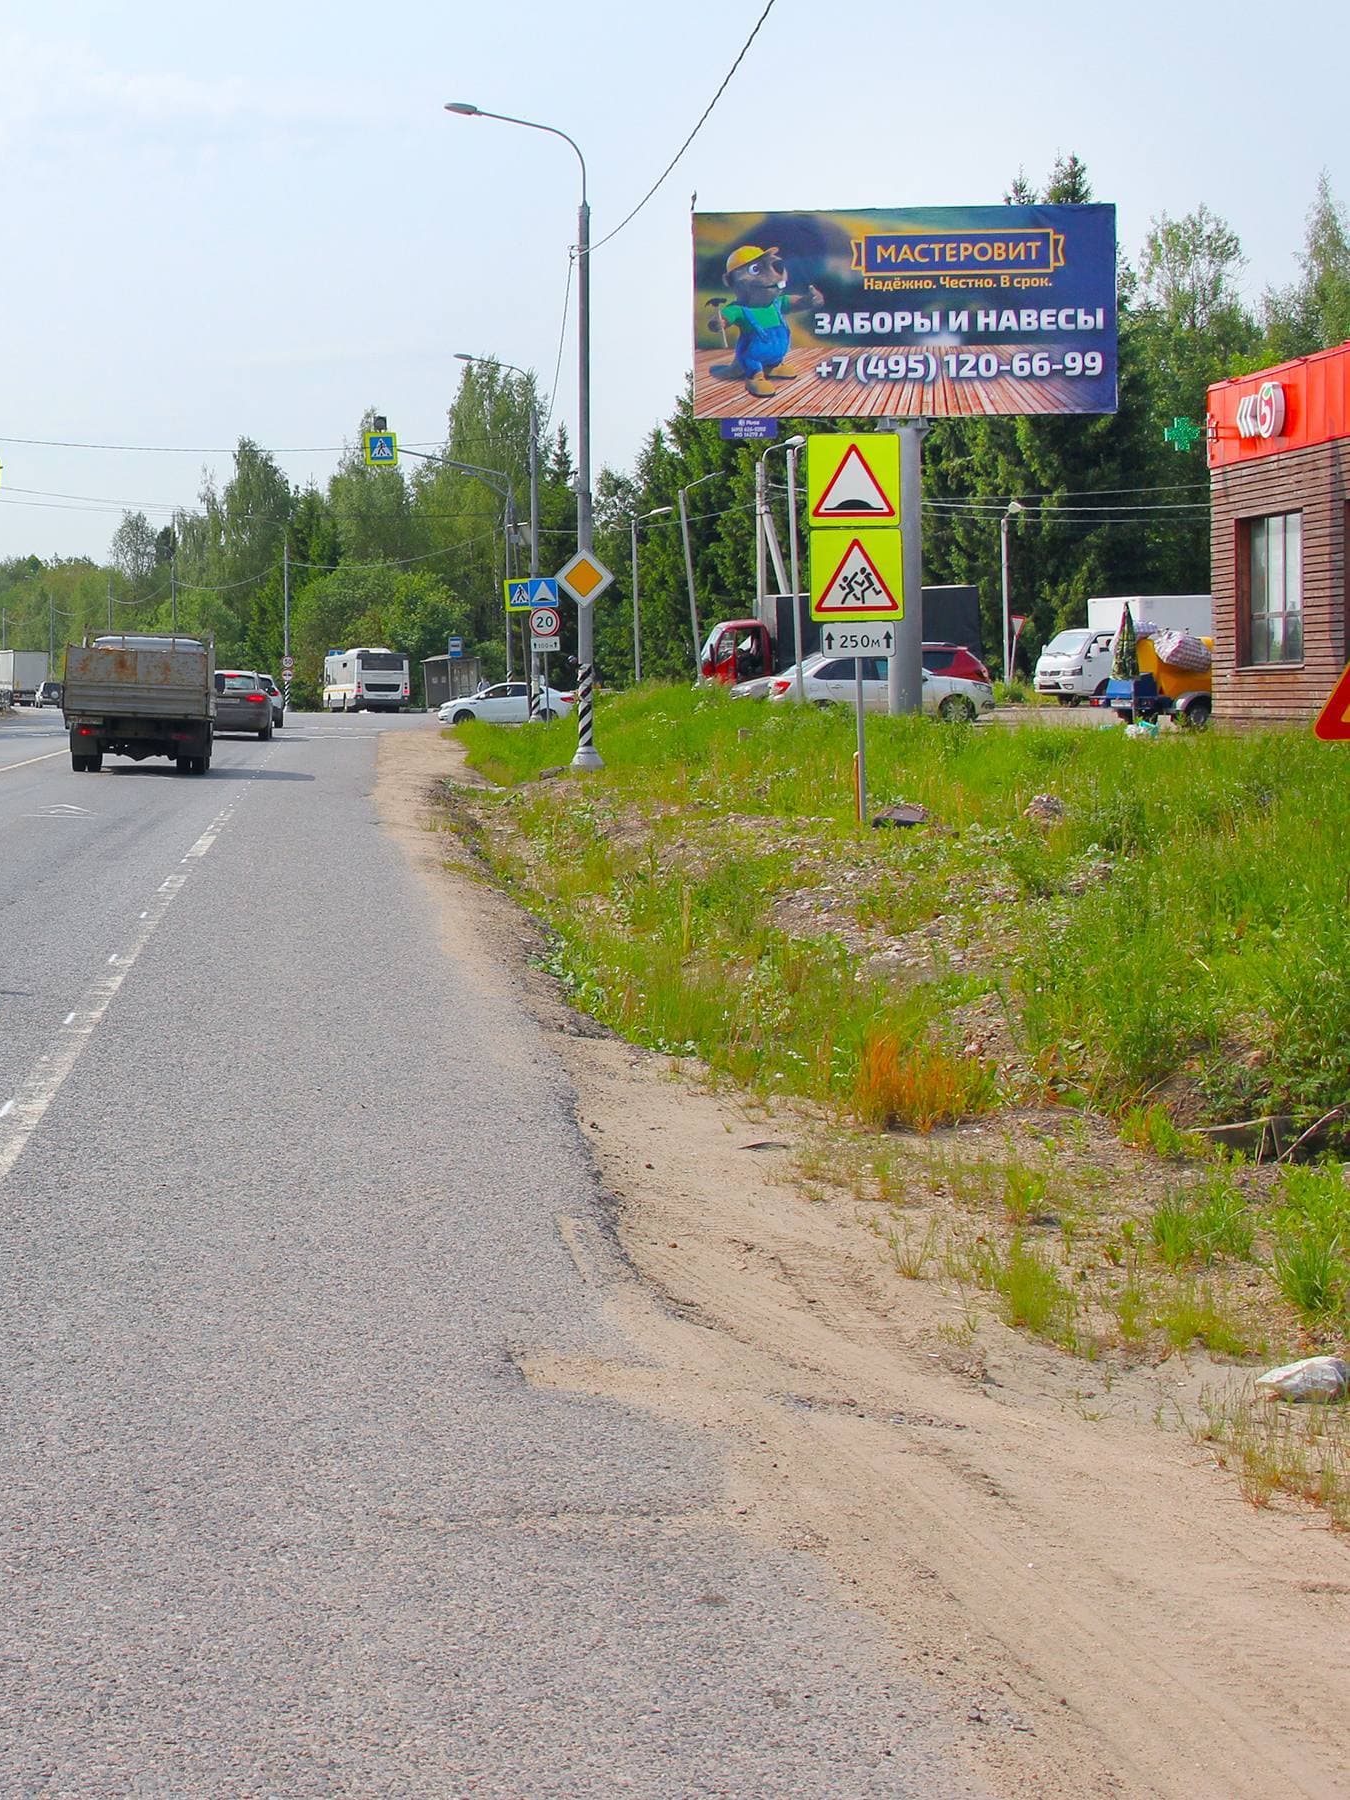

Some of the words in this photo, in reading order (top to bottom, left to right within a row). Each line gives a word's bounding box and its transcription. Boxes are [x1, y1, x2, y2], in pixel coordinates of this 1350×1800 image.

[876, 241, 1042, 263] МАСТЕРОВИТ
[863, 278, 937, 292] Надёжно.
[939, 276, 996, 289] Честно.
[1001, 275, 1011, 288] В
[1013, 276, 1052, 290] срок.
[814, 311, 940, 334] ЗАБОРЫ
[948, 310, 969, 333] И
[976, 308, 1104, 331] НАВЕСЫ
[816, 355, 849, 379] +7
[856, 353, 937, 383] (495)
[944, 351, 1103, 378] 120-66-99
[536, 616, 554, 628] 20
